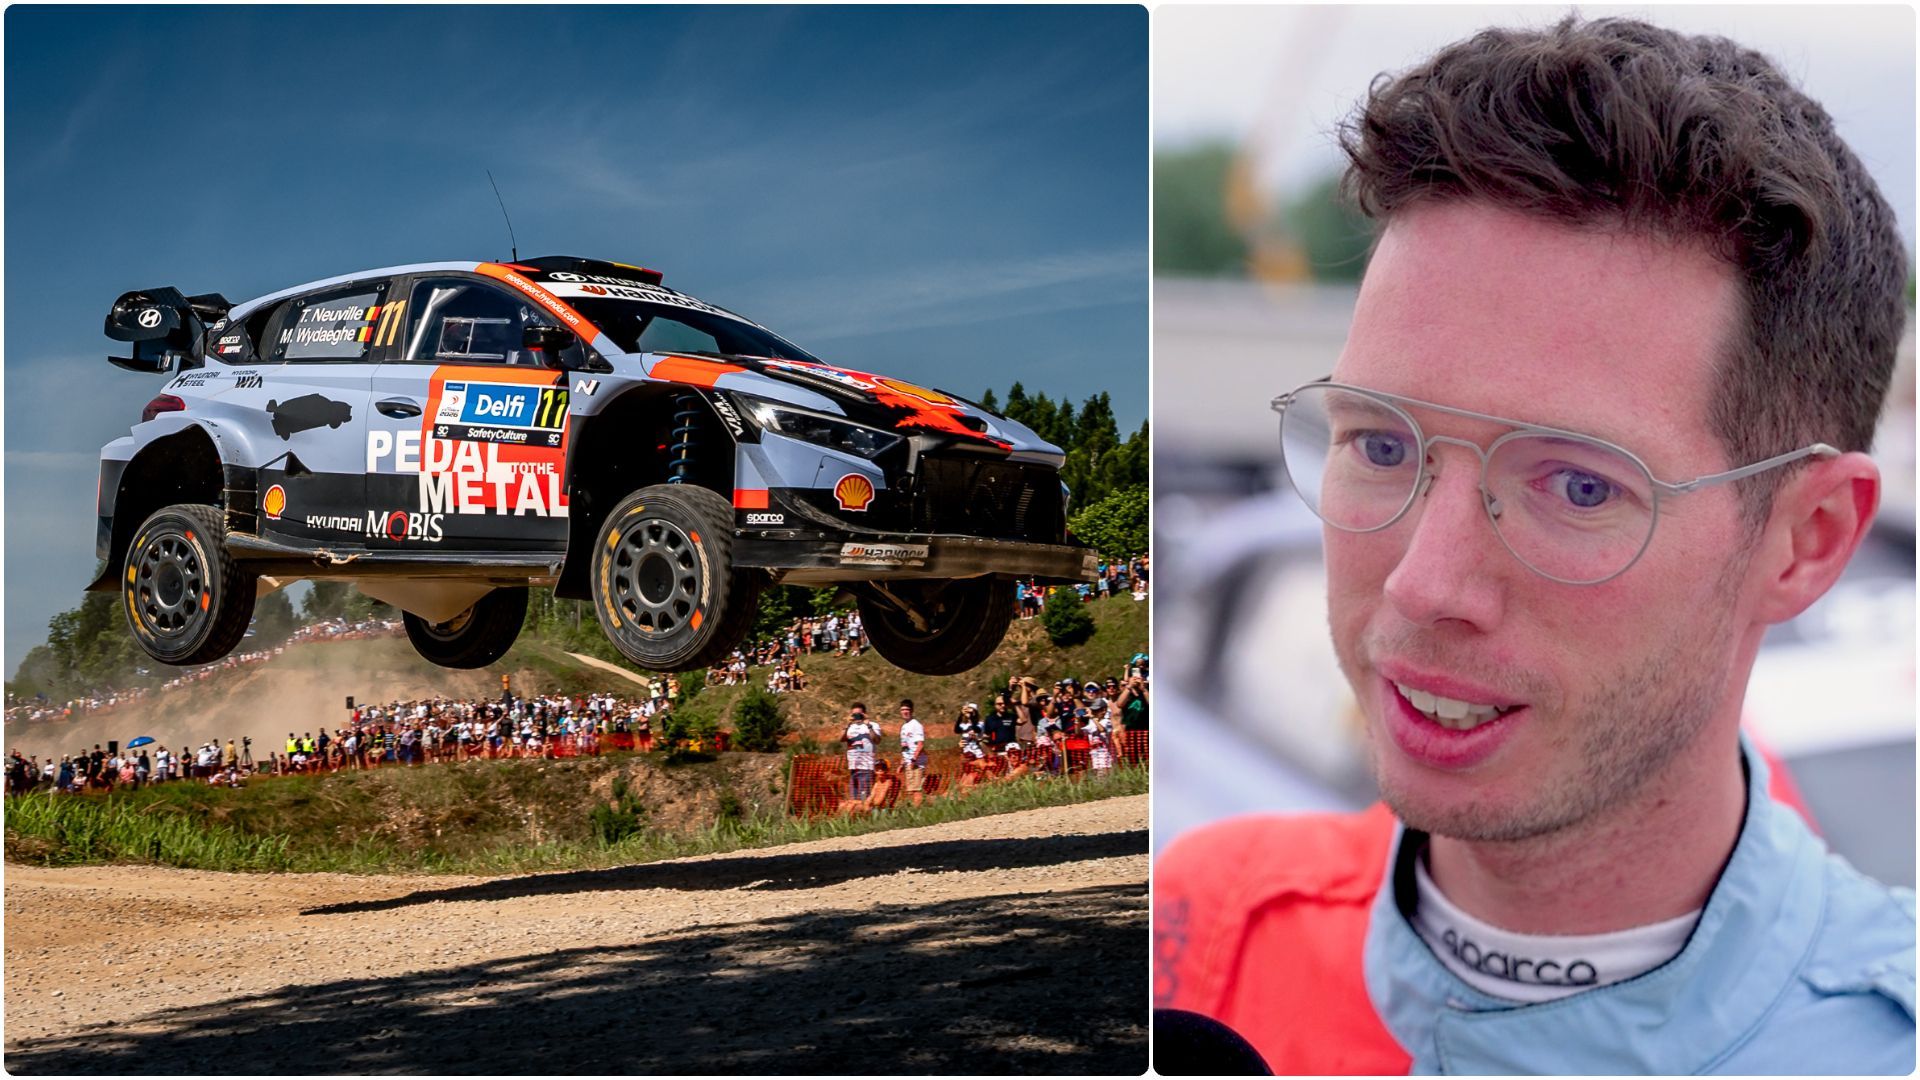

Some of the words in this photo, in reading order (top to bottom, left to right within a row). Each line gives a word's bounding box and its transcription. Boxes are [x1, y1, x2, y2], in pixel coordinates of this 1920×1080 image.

[300, 309, 312, 323] T.
[312, 306, 364, 323] Neuville
[375, 300, 407, 347] 11
[280, 328, 293, 344] M.
[296, 326, 356, 346] Wydaeghe
[474, 394, 525, 418] Delfi
[540, 389, 568, 428] 11
[467, 427, 528, 441] SafetyCulture
[367, 430, 516, 475] PEDAL
[418, 471, 569, 518] METAL
[306, 514, 362, 532] HYUNDAI
[366, 509, 444, 541] MOBIS
[746, 513, 784, 524] sparco
[1442, 930, 1598, 987] sparco
